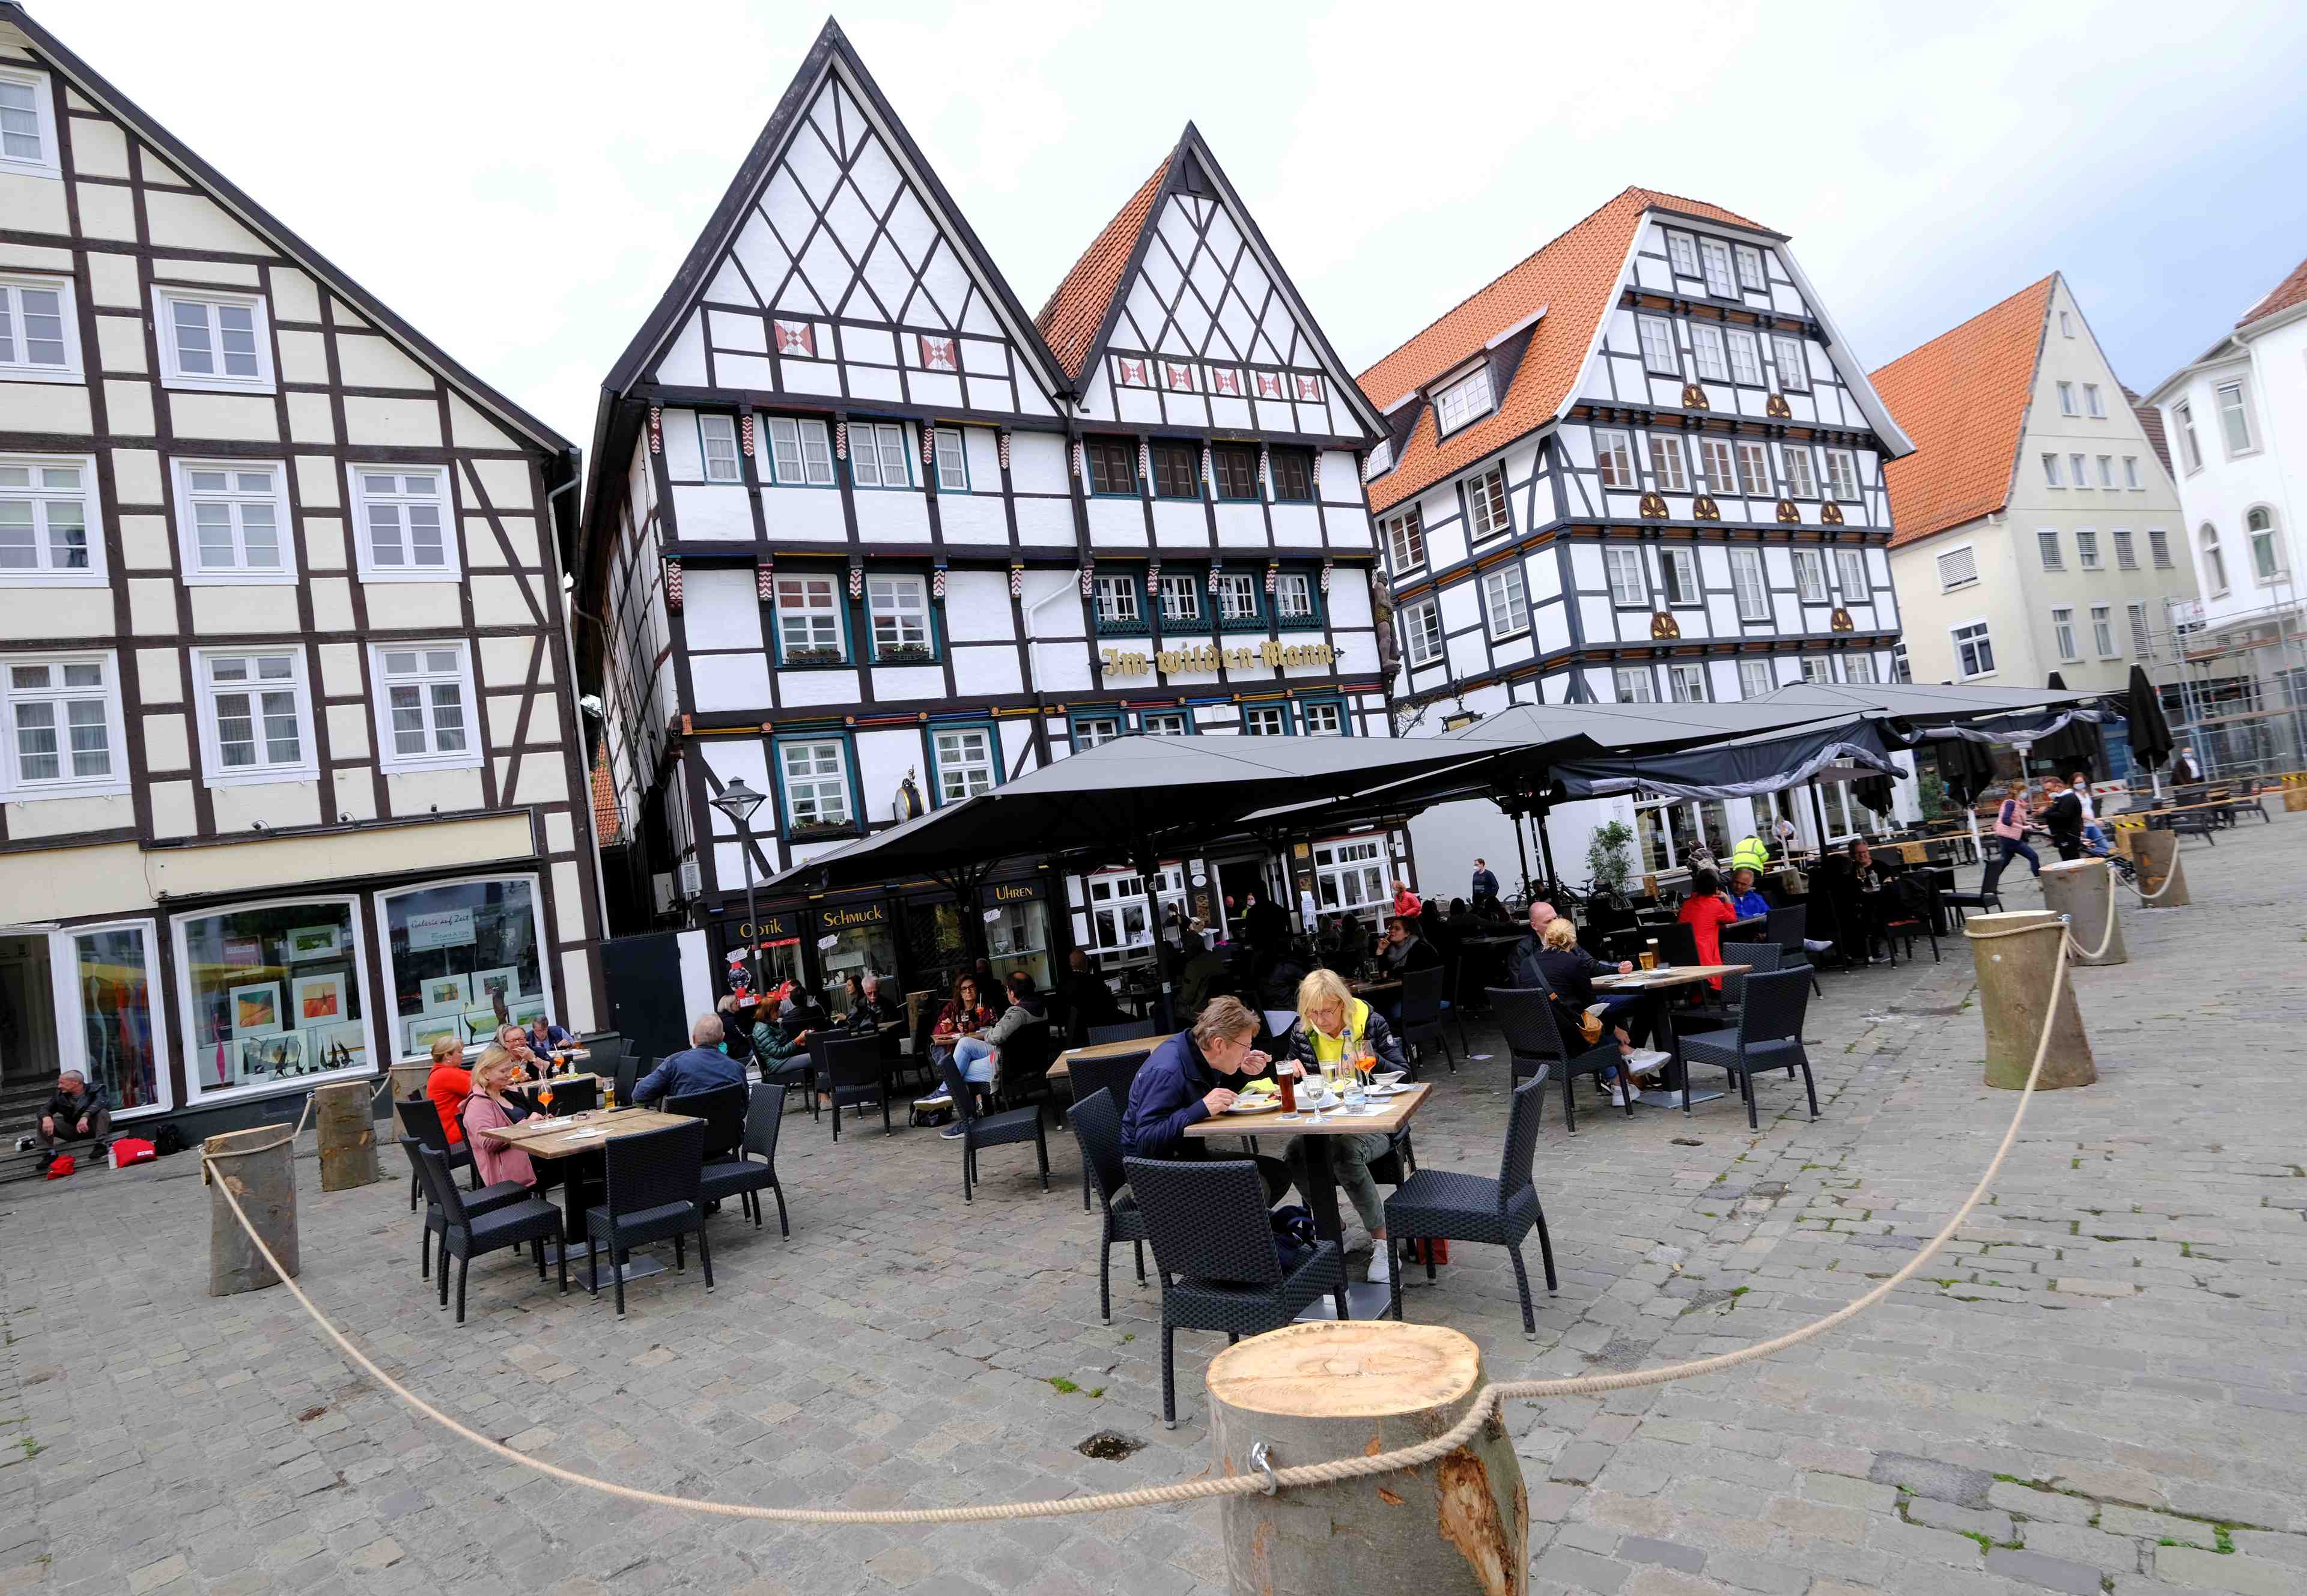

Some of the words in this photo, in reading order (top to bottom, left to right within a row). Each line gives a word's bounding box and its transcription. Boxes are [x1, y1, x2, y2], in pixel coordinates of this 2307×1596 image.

[1102, 648, 1149, 676] Im
[1155, 643, 1255, 673] wilden
[1259, 640, 1334, 668] Mann
